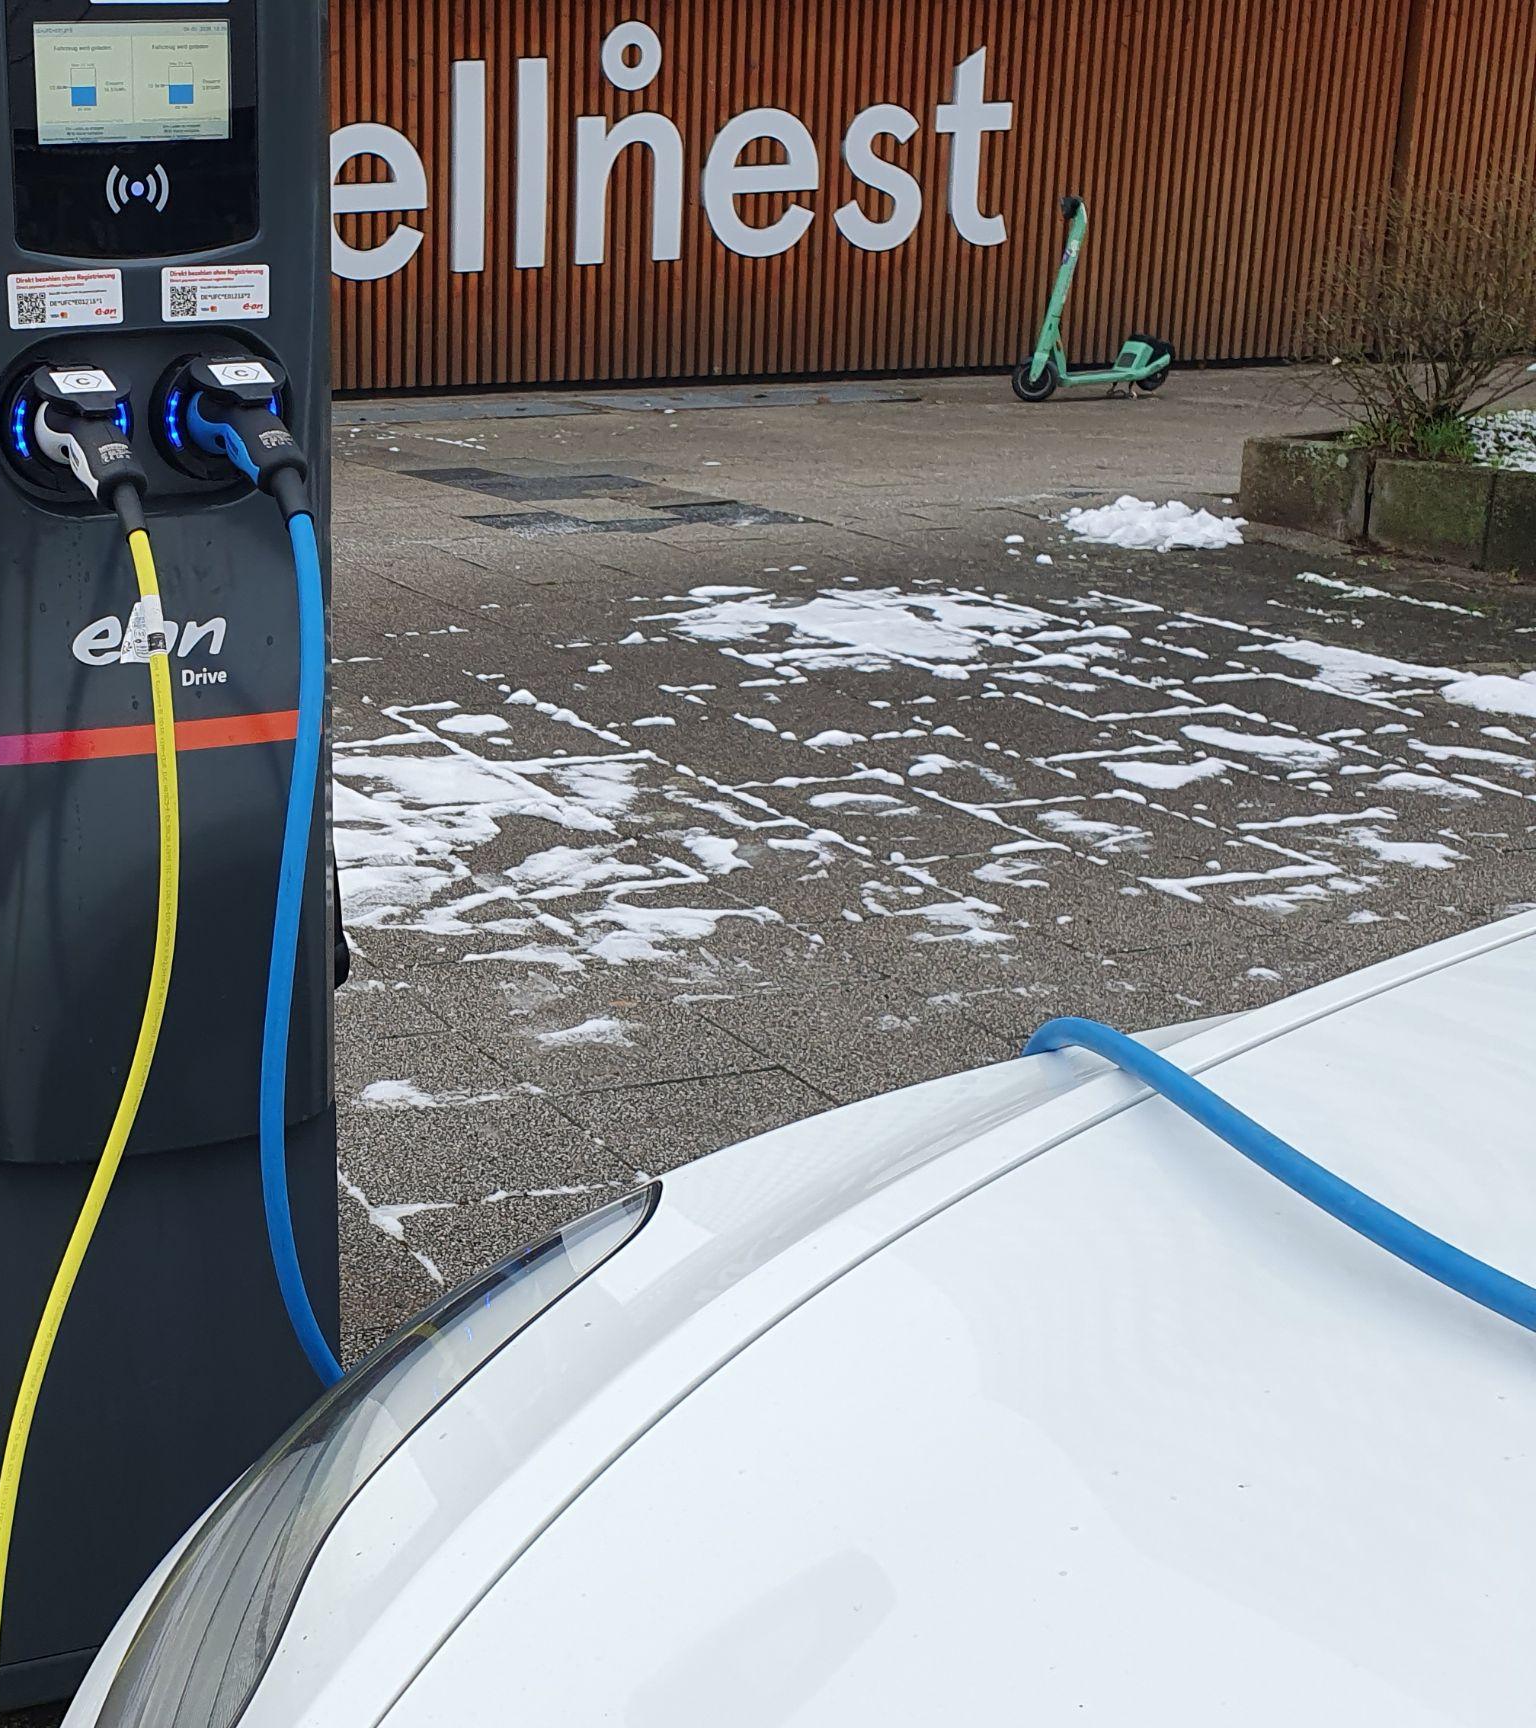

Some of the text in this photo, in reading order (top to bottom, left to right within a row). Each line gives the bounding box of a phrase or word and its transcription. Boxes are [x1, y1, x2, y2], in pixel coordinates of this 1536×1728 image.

[227, 268, 264, 276] Registrierung
[35, 275, 61, 283] bezahlen
[76, 272, 116, 282] Registrierung
[234, 368, 249, 378] C
[76, 376, 90, 386] C
[181, 667, 227, 687] Drive
